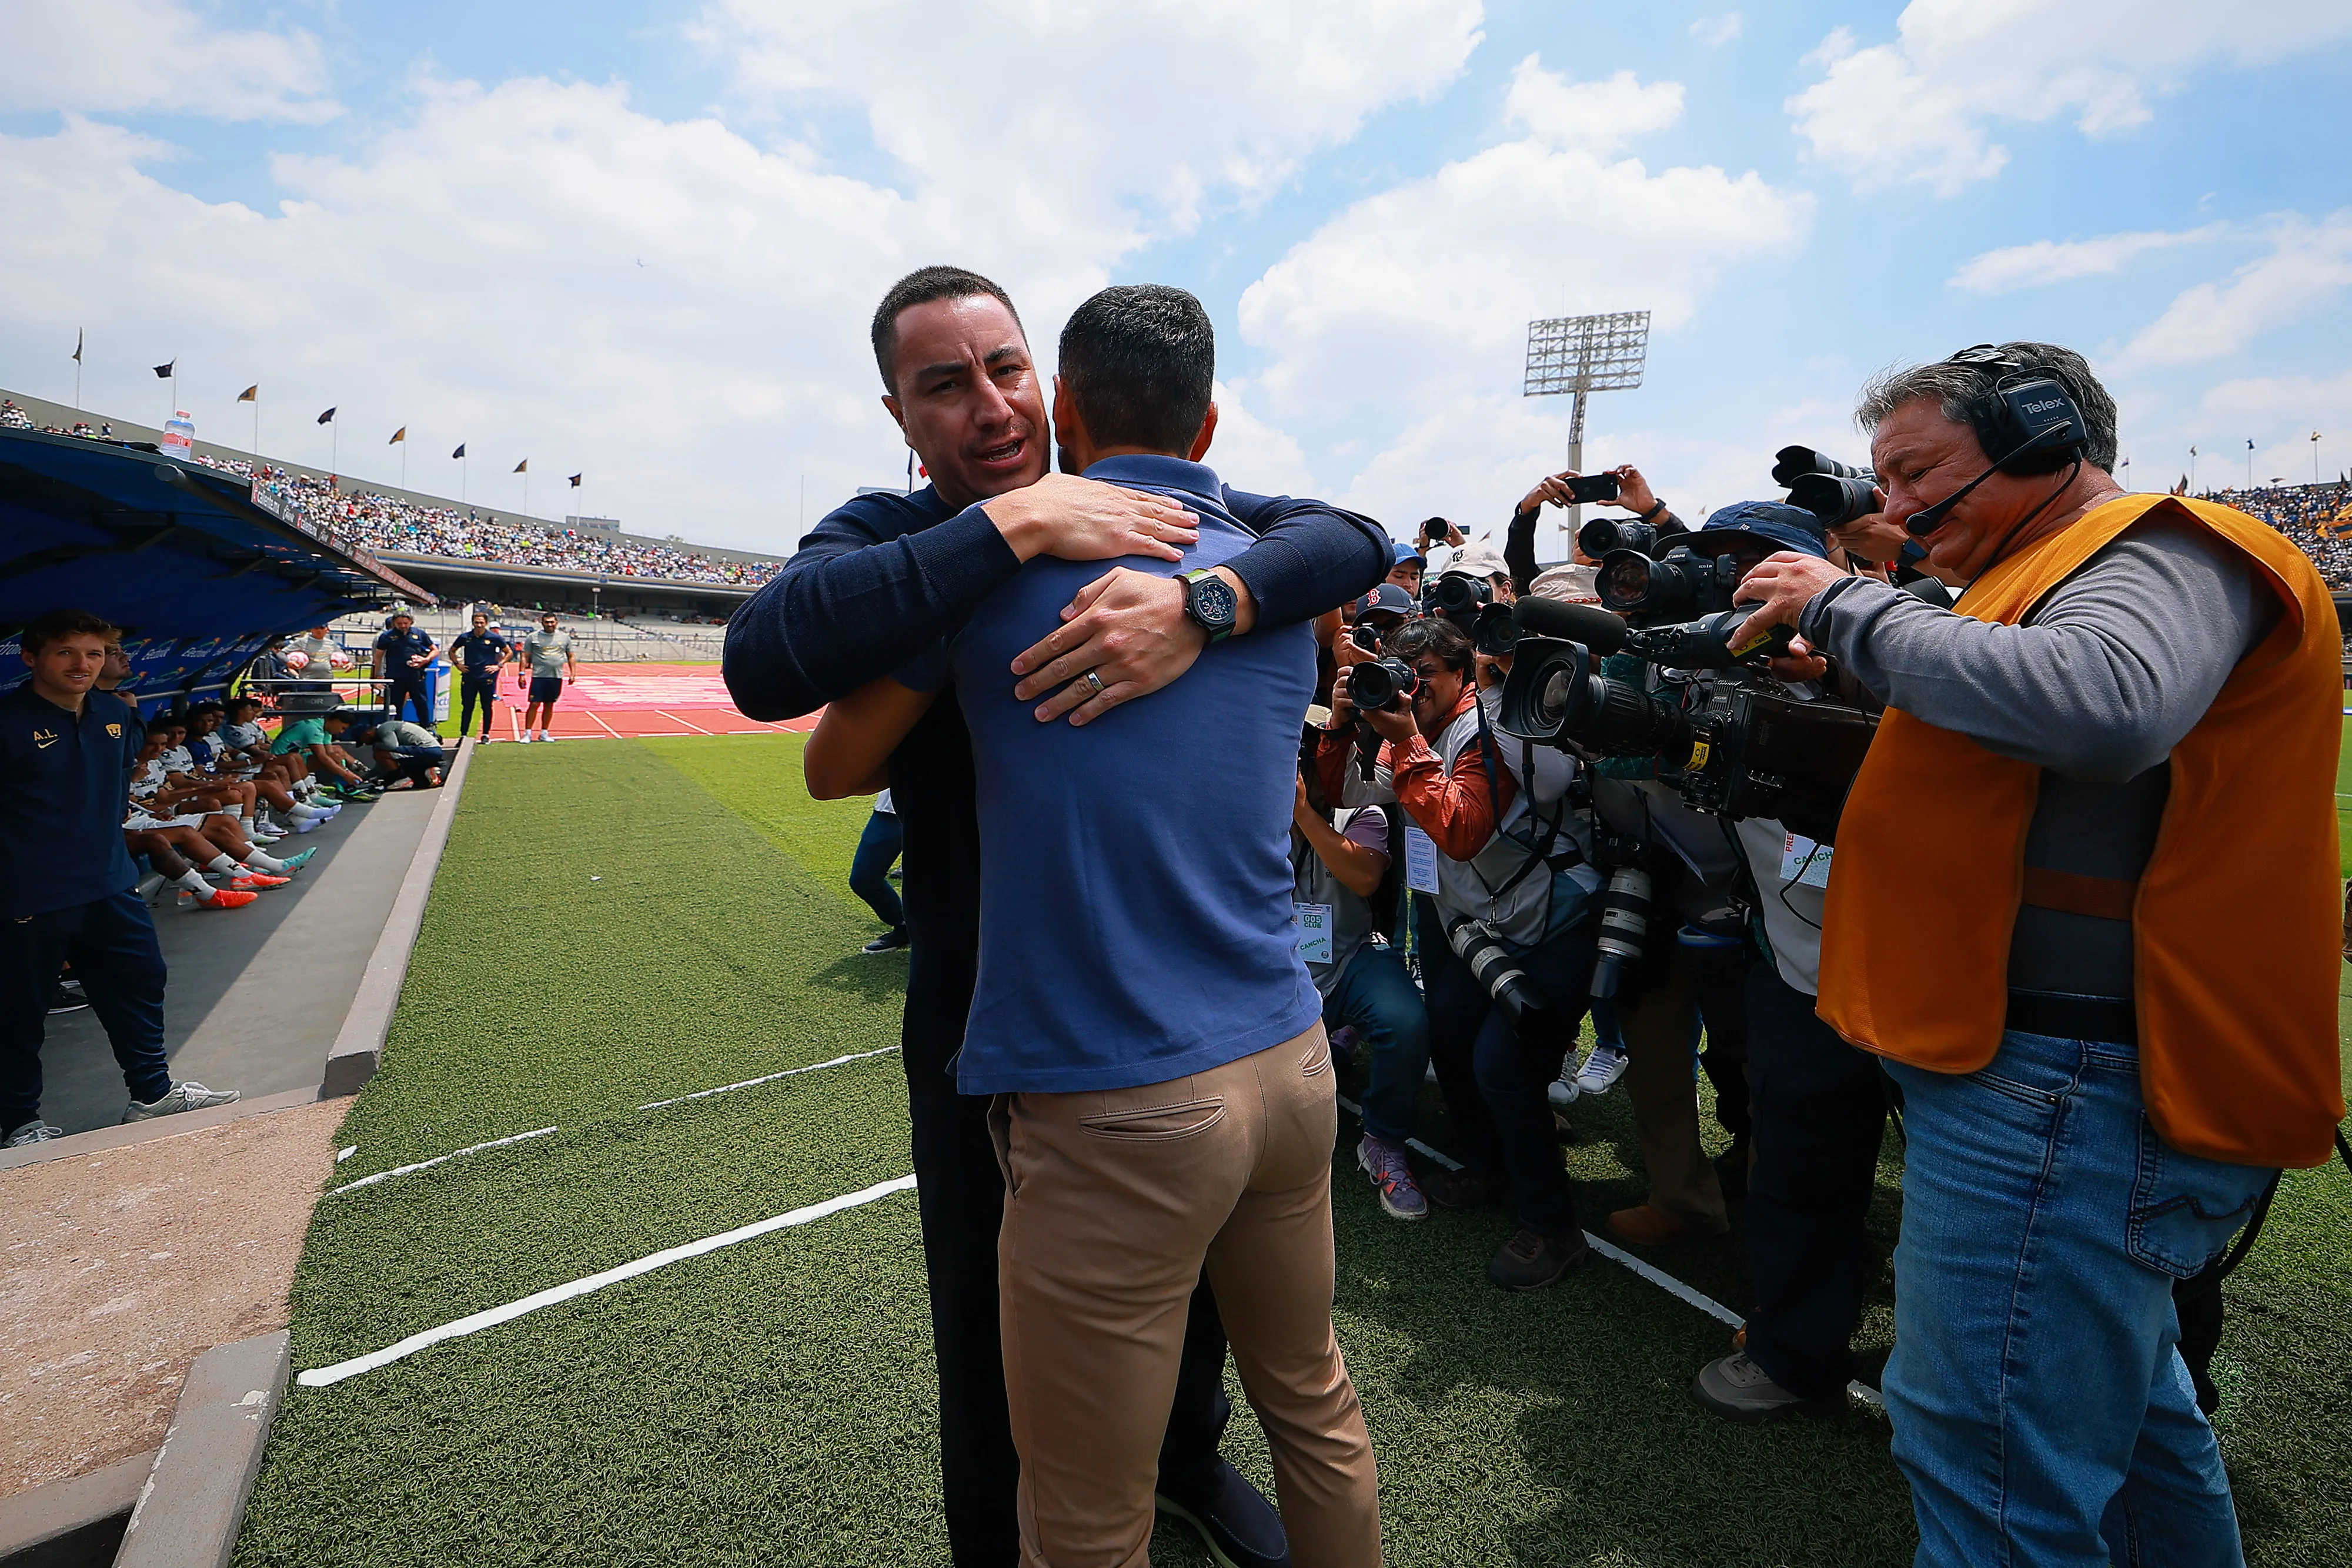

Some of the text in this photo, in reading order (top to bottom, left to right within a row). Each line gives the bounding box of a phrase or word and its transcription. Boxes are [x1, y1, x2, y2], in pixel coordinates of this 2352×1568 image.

[2021, 398, 2065, 414] Telex
[34, 728, 58, 741] A.L.
[1300, 937, 1326, 950] CANCHA
